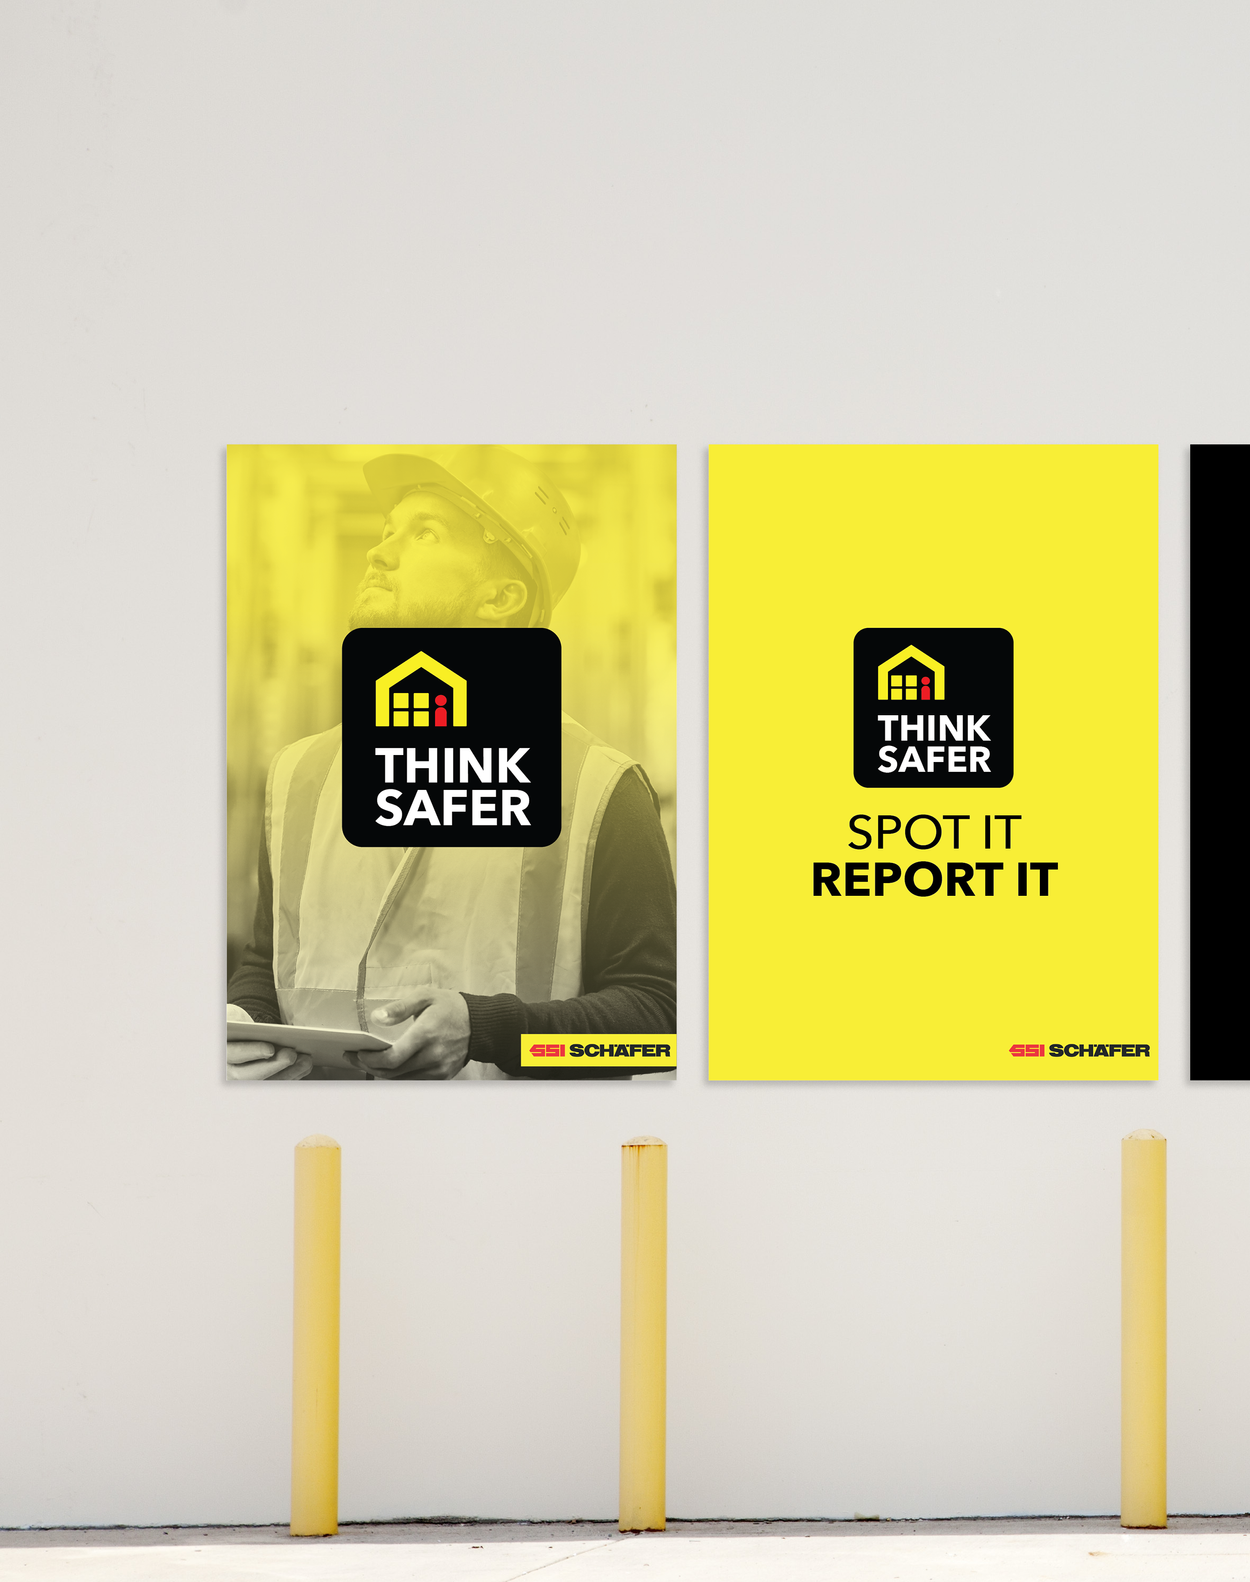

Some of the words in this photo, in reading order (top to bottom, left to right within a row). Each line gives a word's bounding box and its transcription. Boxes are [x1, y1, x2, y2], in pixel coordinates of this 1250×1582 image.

[878, 715, 991, 741] THINK
[375, 748, 531, 783] THINK
[878, 745, 991, 773] SAFER
[376, 789, 531, 826] SAFER
[849, 814, 970, 850] SPOT
[985, 815, 1022, 849] IT
[813, 861, 1003, 897] REPORT
[1018, 862, 1058, 896] IT
[570, 1044, 670, 1057] SCHÄFER
[1049, 1044, 1150, 1057] SCHÄFER
